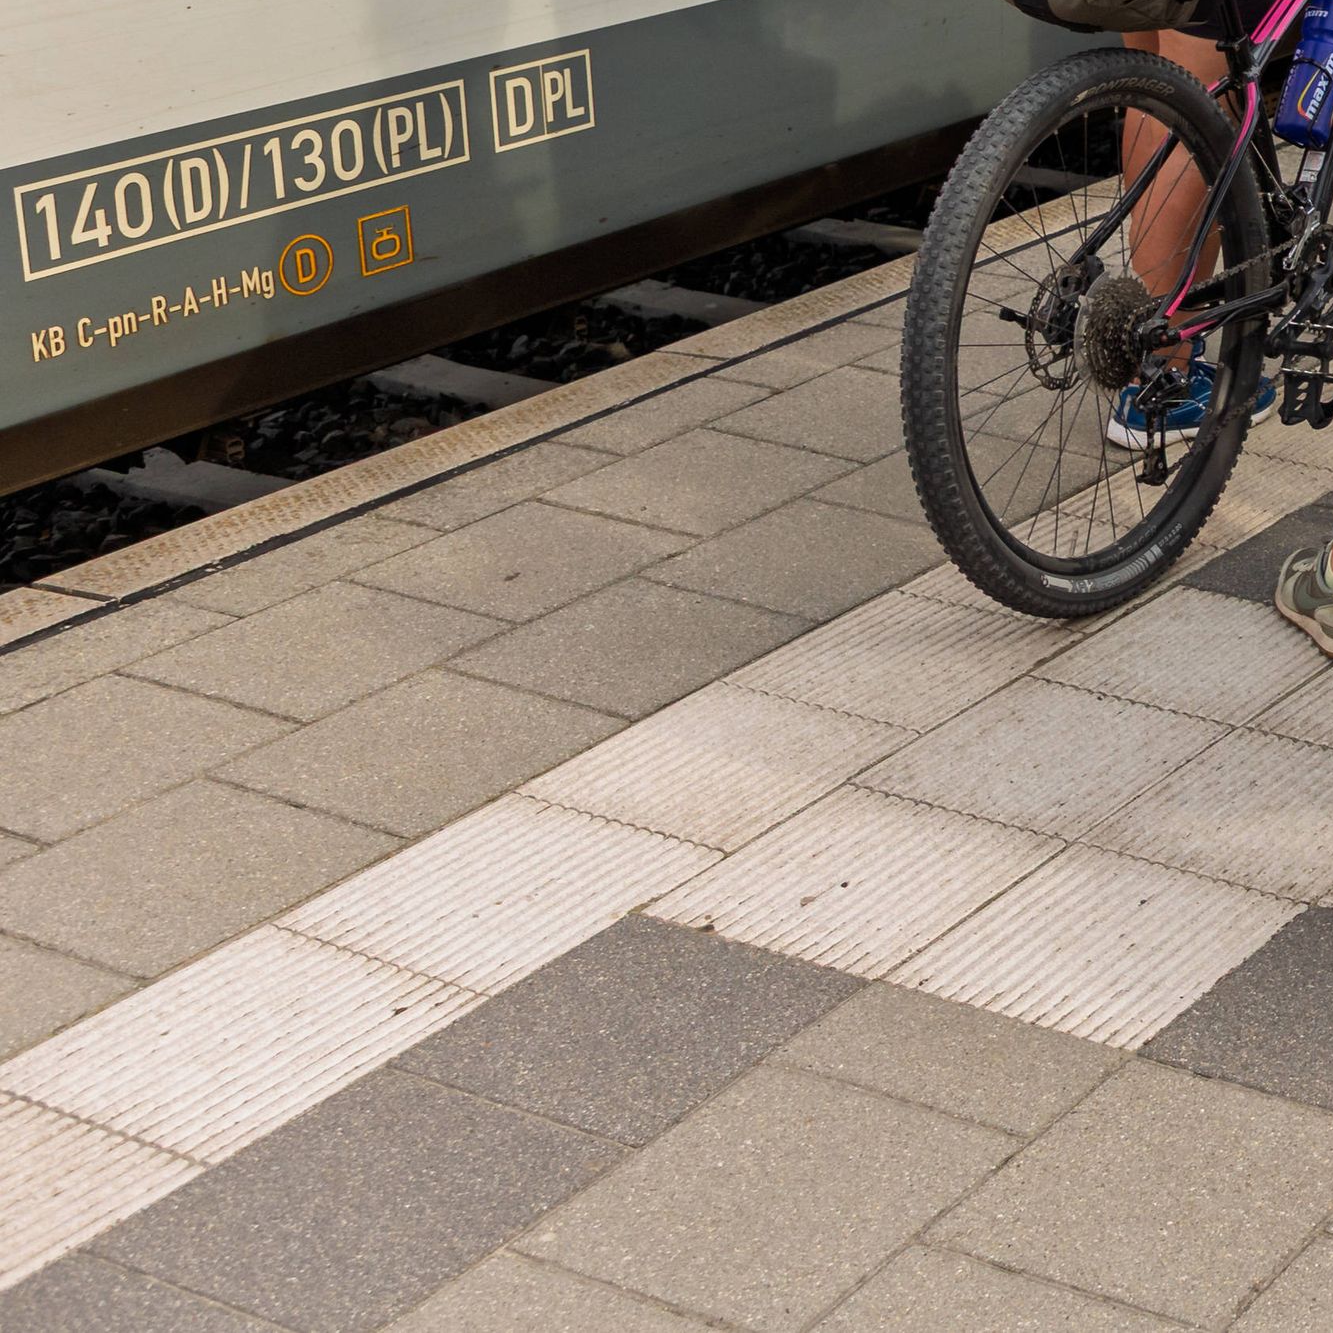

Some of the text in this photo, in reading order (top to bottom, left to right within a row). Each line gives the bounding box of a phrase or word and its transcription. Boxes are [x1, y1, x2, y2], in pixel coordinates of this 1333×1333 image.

[506, 67, 585, 138] D PL
[35, 92, 454, 262] 140(D)/130(PL)
[31, 325, 67, 362] KB
[77, 267, 276, 350] C-pn-R-A-H-Mg
